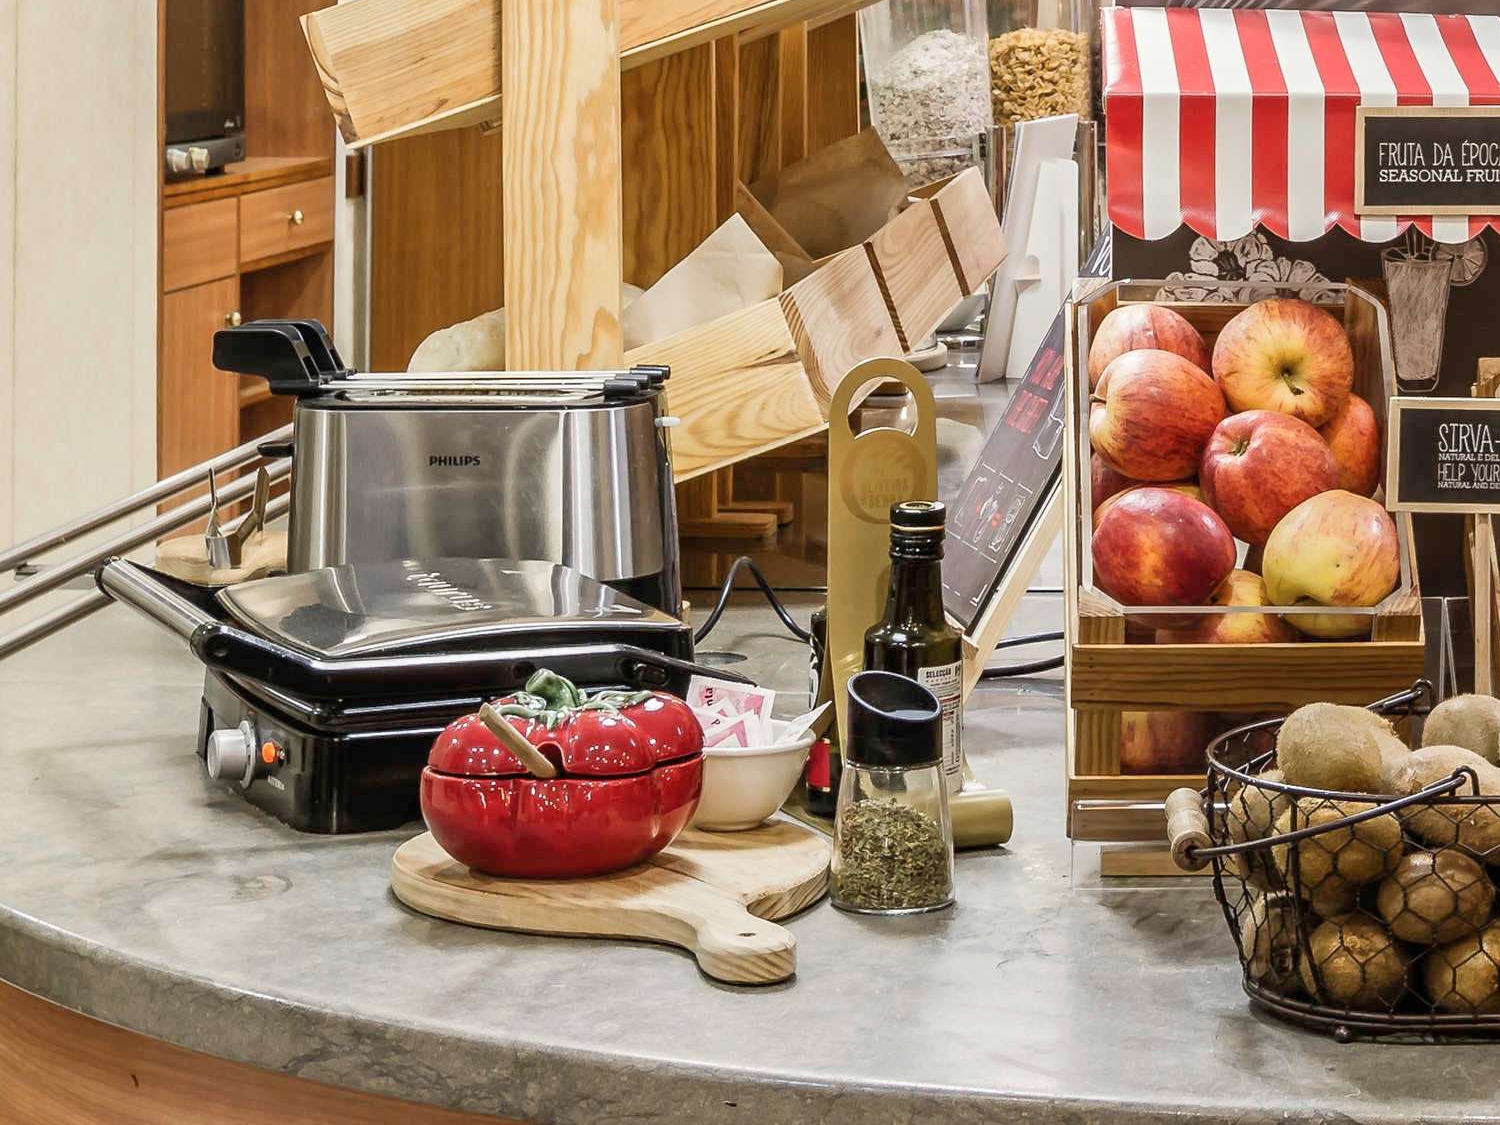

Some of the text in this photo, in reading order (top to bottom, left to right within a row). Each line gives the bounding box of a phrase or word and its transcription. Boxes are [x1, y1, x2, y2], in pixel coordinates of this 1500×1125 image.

[1380, 143, 1425, 166] FRUTA
[1433, 143, 1454, 166] DA
[1380, 169, 1462, 182] SEASONAL
[429, 456, 481, 467] PHILIPS
[1439, 453, 1476, 461] NATURAL
[1437, 463, 1466, 482] HELP
[1437, 481, 1471, 489] NATURAL
